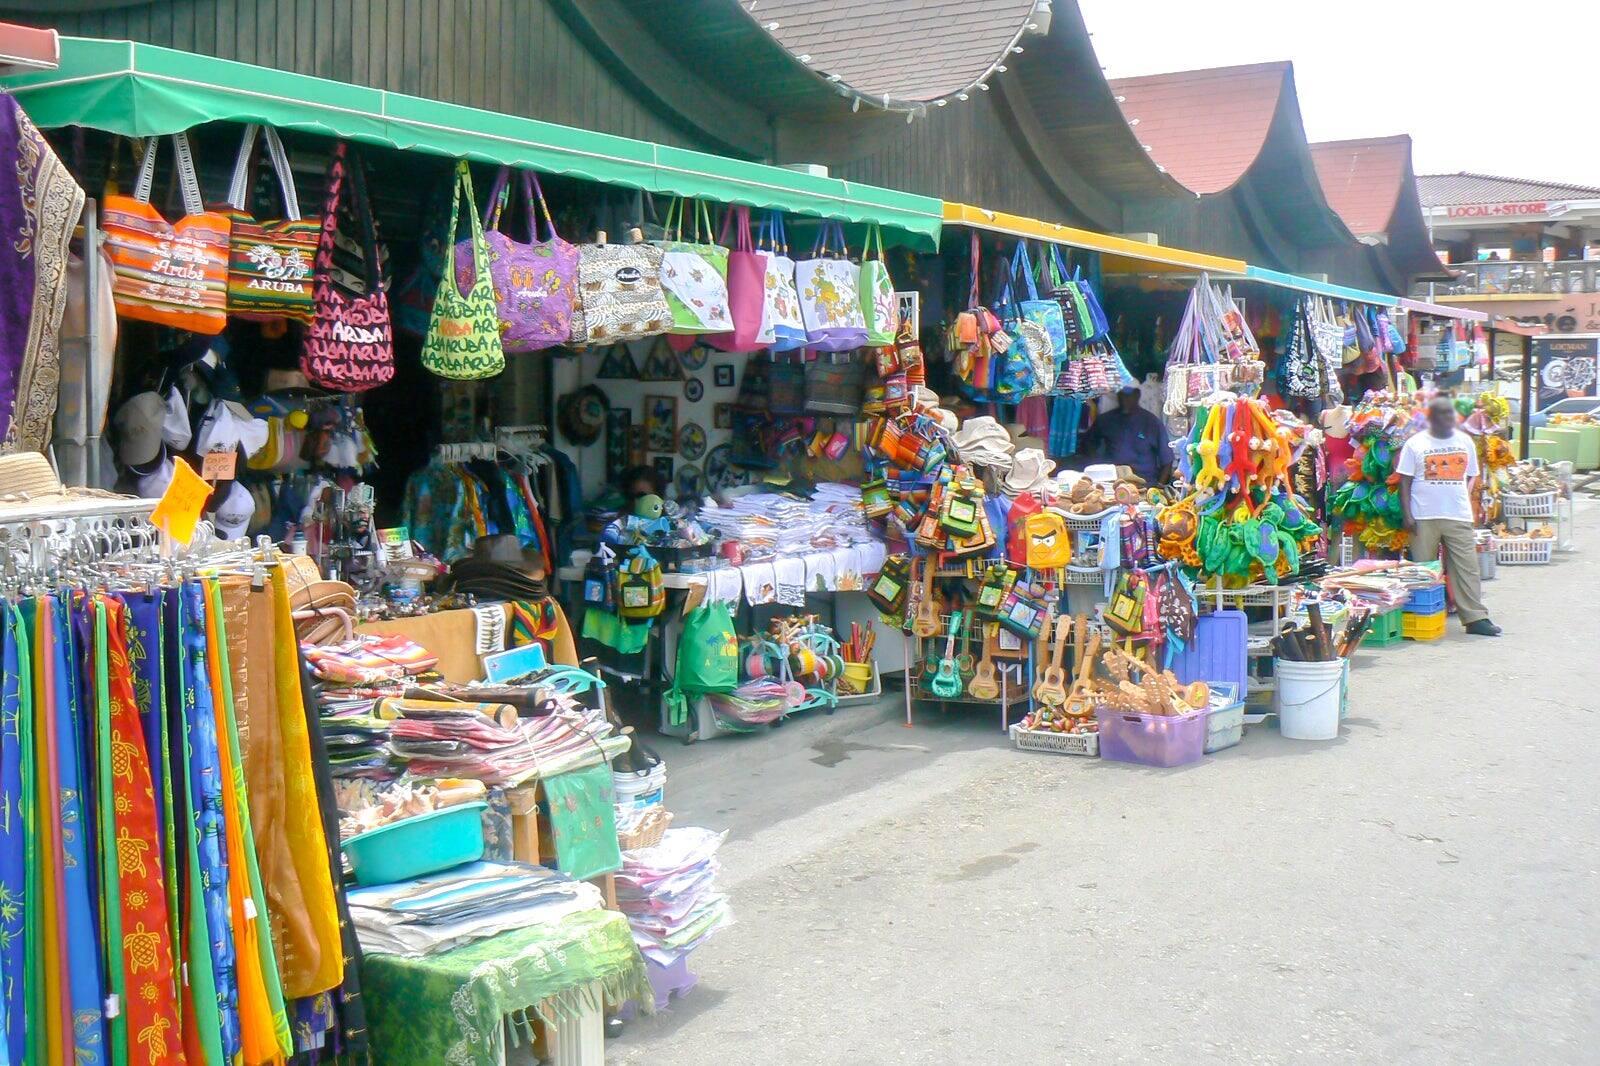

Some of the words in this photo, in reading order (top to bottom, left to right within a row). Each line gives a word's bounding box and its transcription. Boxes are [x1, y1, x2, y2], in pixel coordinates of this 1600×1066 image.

[151, 258, 205, 281] Aruba
[247, 278, 305, 294] ARUBA
[515, 286, 548, 298] Aruba
[332, 320, 384, 344] ARUBA
